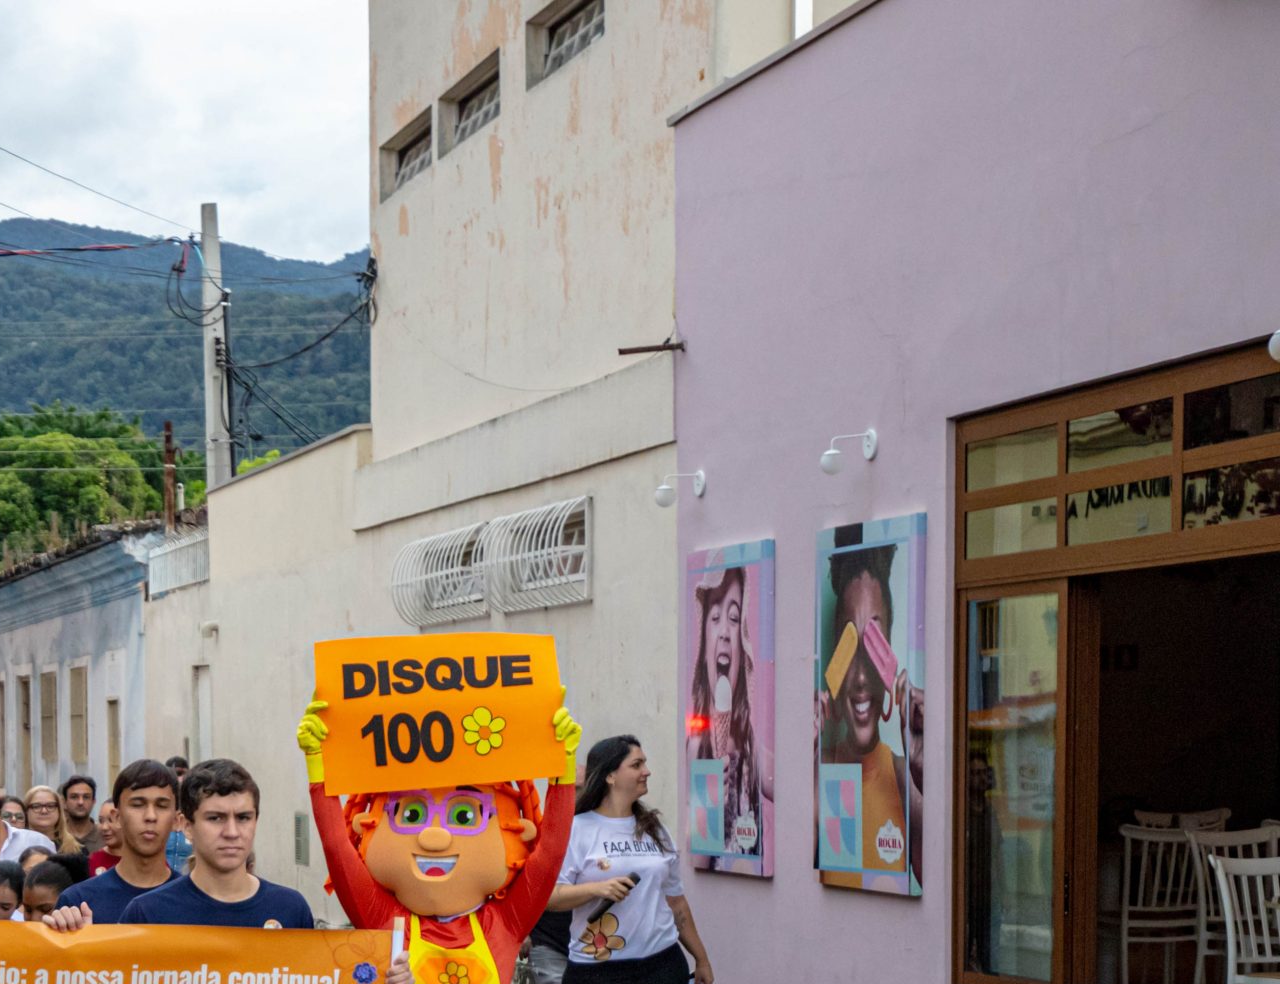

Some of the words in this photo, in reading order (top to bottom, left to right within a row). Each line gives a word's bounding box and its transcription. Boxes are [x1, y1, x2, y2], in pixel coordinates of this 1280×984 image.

[342, 655, 533, 700] DISQUE
[361, 710, 455, 768] 100
[603, 840, 632, 854] FAÇA
[877, 838, 902, 850] ROCHA
